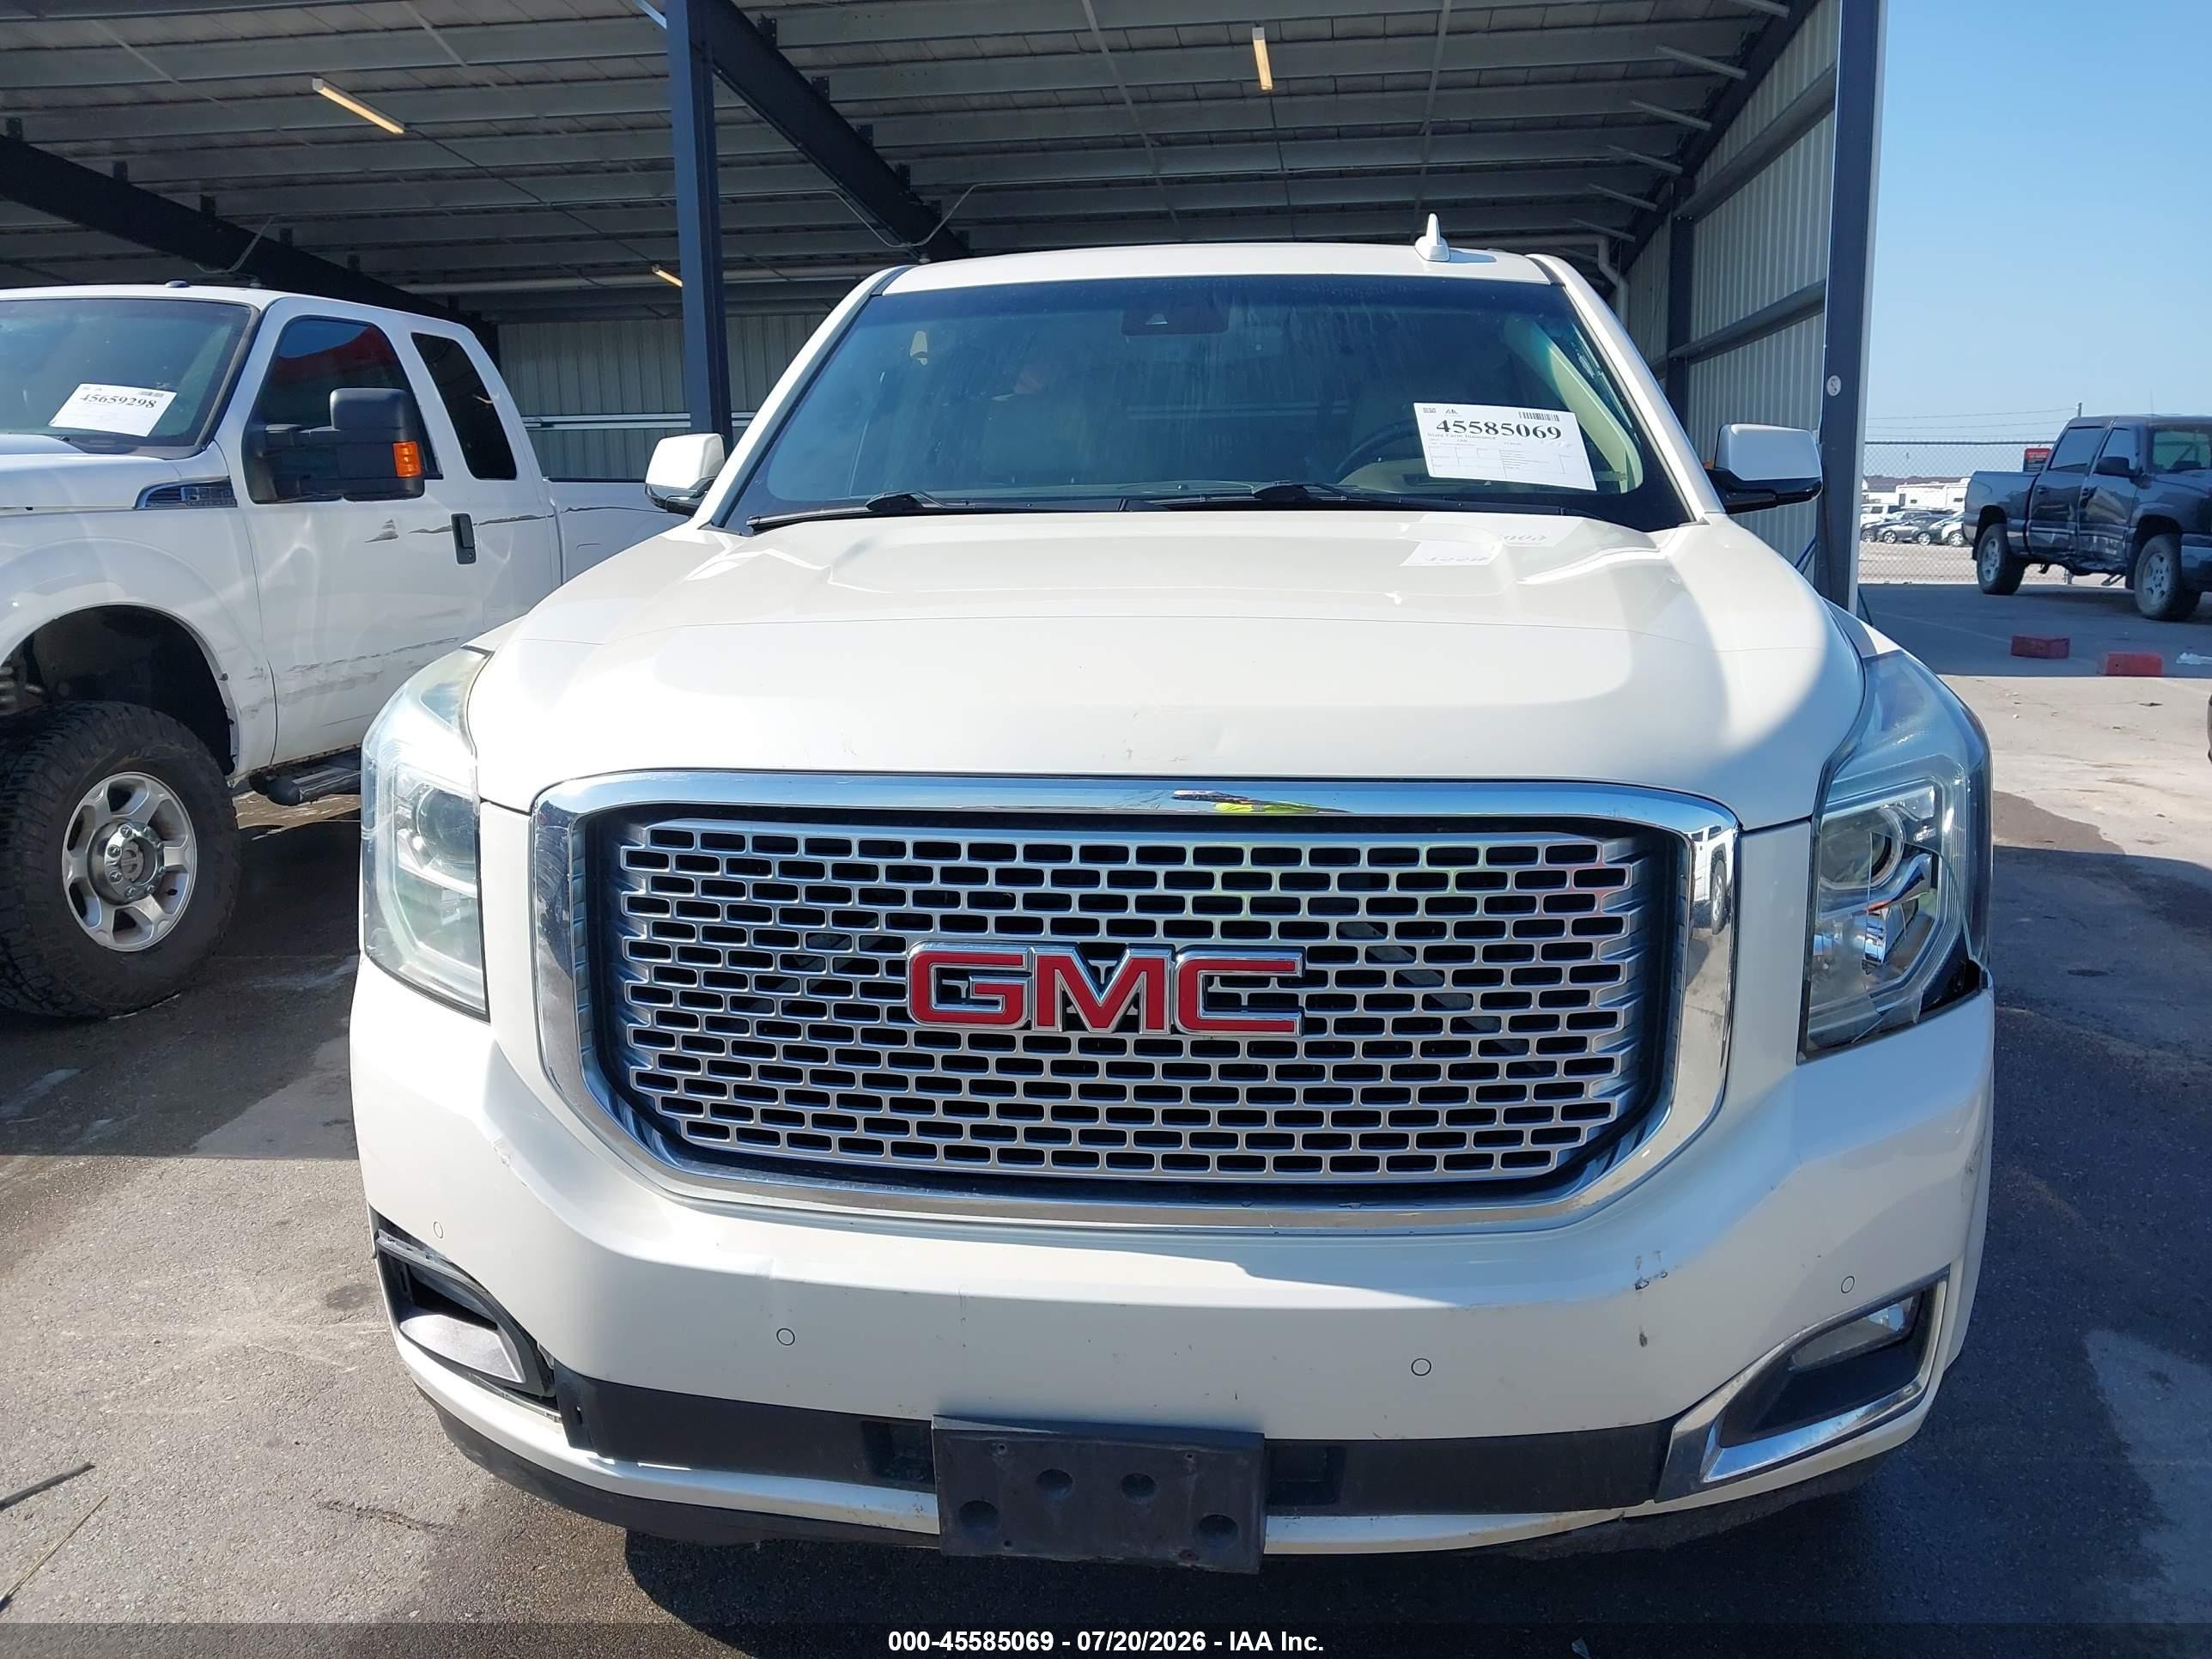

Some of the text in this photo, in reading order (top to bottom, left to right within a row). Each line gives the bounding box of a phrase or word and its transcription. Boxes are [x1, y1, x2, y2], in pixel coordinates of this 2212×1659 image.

[80, 393, 158, 409] 45659298
[1436, 419, 1562, 441] 45585069
[907, 940, 1304, 1036] GMC
